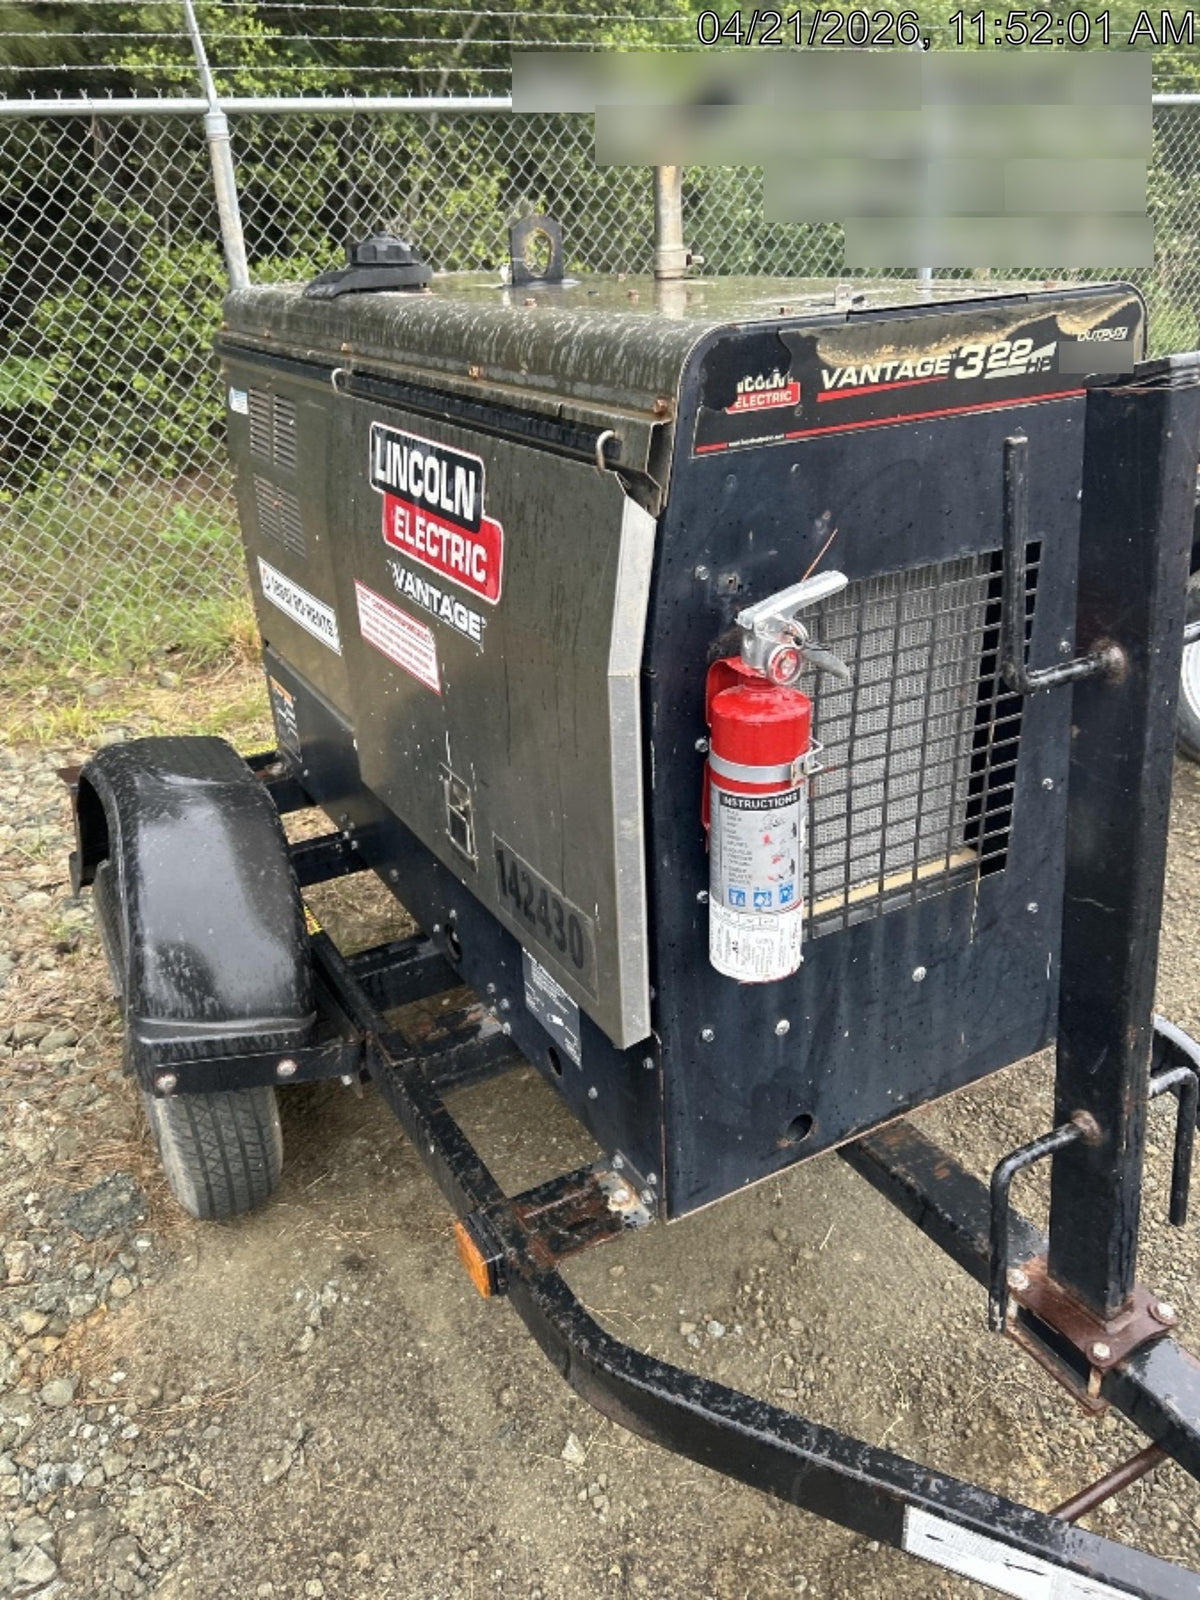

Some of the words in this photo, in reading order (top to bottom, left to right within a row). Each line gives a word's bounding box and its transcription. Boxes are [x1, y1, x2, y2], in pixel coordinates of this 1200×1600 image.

[737, 372, 785, 393] NCOLN
[820, 353, 951, 390] VANTAGE
[954, 338, 1034, 379] 322
[735, 390, 792, 409] ELECTRIC
[373, 437, 476, 522] LINCOLN
[393, 504, 488, 583] ELECTRIC
[392, 565, 486, 643] VANTAGE
[721, 792, 797, 809] INSTRUCTIONS
[495, 849, 584, 970] 142430
